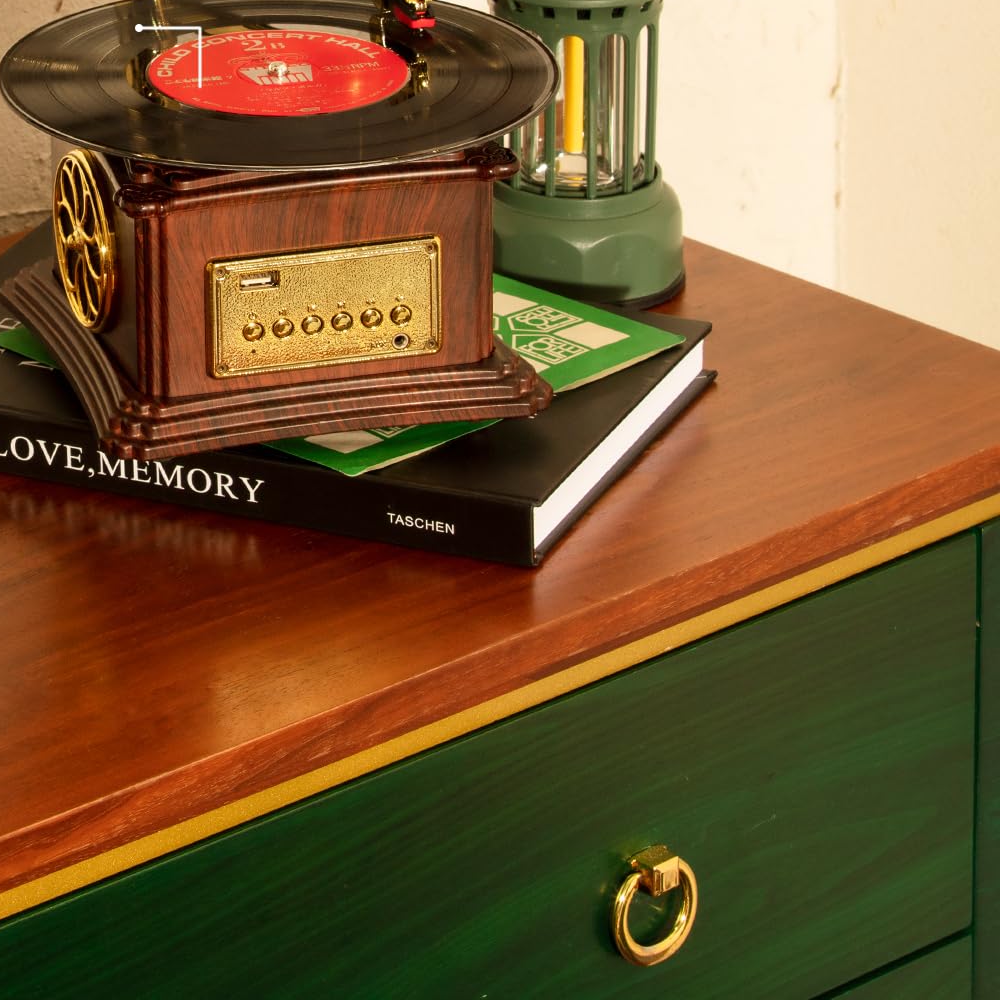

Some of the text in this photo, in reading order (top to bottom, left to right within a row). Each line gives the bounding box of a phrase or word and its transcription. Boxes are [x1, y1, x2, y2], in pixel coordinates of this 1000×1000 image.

[157, 32, 380, 77] CHILD CONCERT HALL
[386, 512, 455, 535] TASCHEN
